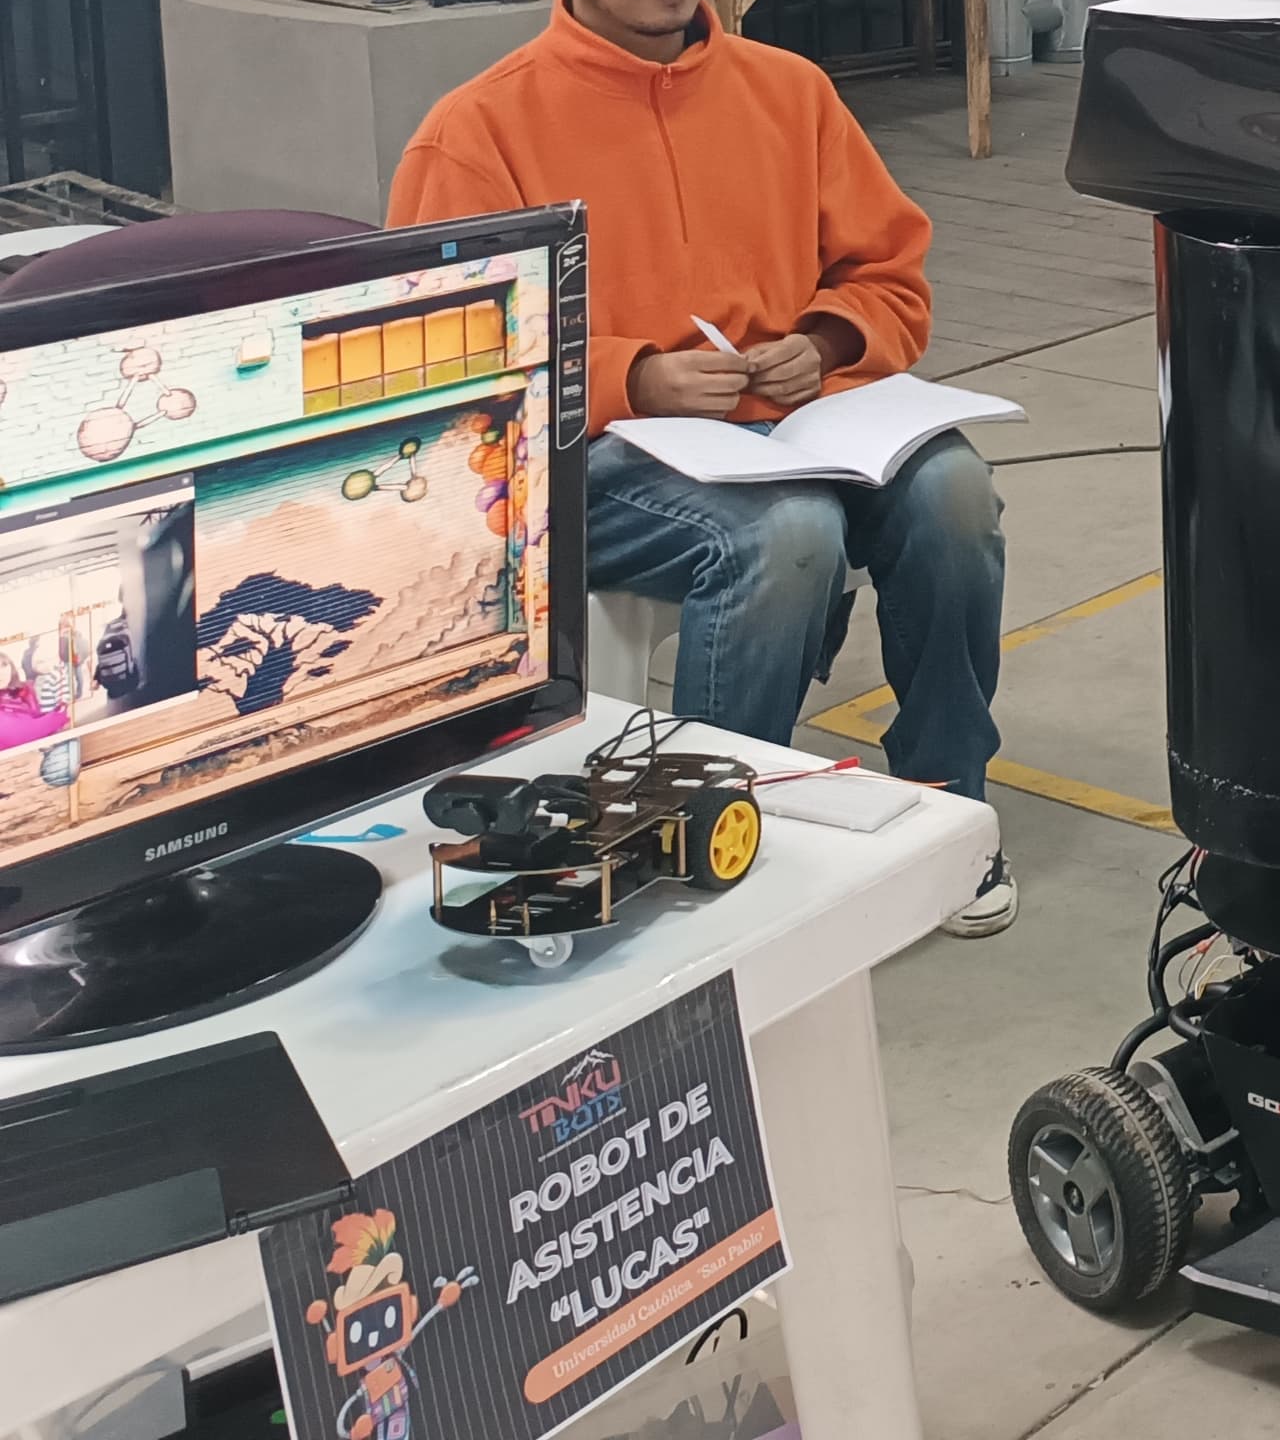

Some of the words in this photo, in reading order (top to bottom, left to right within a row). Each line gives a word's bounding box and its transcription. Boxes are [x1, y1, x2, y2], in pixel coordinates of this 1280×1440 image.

[144, 822, 228, 862] SAMSUNG
[506, 1136, 735, 1305] ASISTENCIA
[508, 1116, 651, 1234] ROBOT
[658, 1082, 712, 1143] DE
[552, 1312, 637, 1379] Universidad
[637, 1277, 694, 1322] Católica
